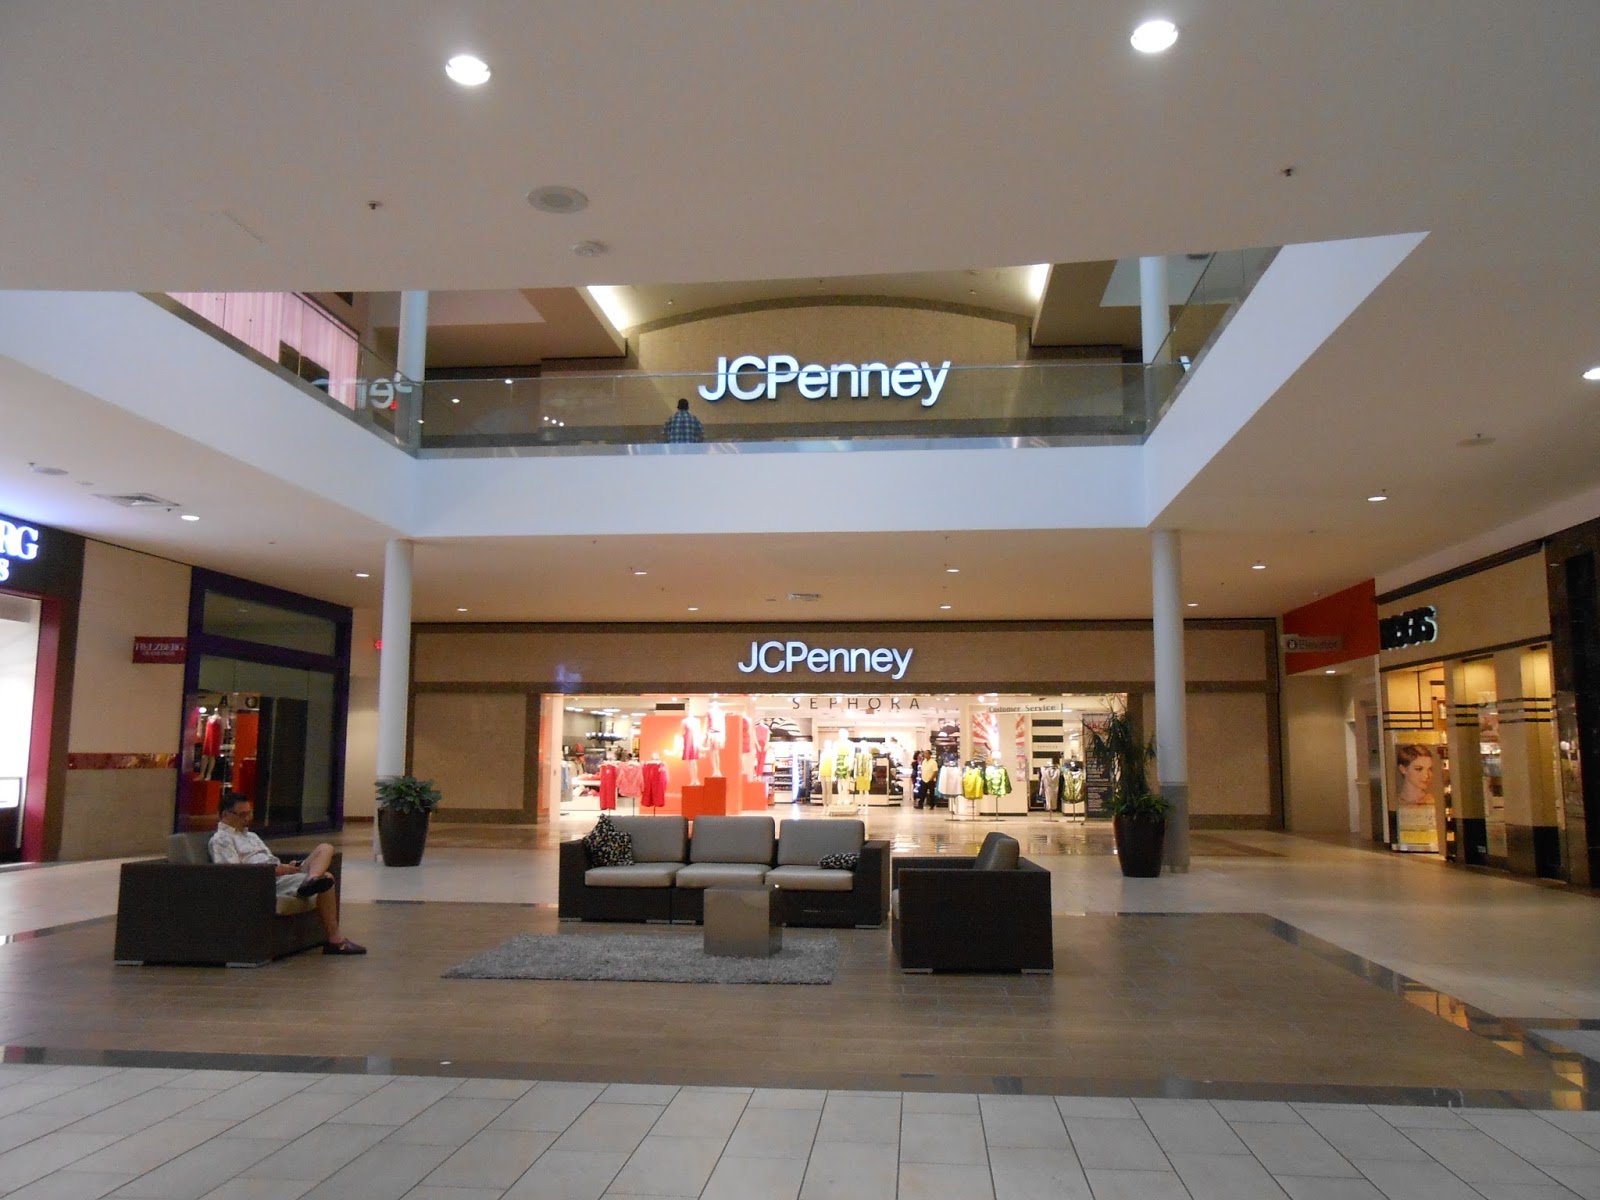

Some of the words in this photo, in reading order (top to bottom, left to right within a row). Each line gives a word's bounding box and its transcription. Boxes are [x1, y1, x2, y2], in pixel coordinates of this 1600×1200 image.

[698, 354, 951, 407] JCPenney
[737, 640, 914, 680] JCPenney
[792, 697, 920, 710] SEPHORA
[988, 705, 1021, 713] Customer
[1025, 704, 1056, 712] Service
